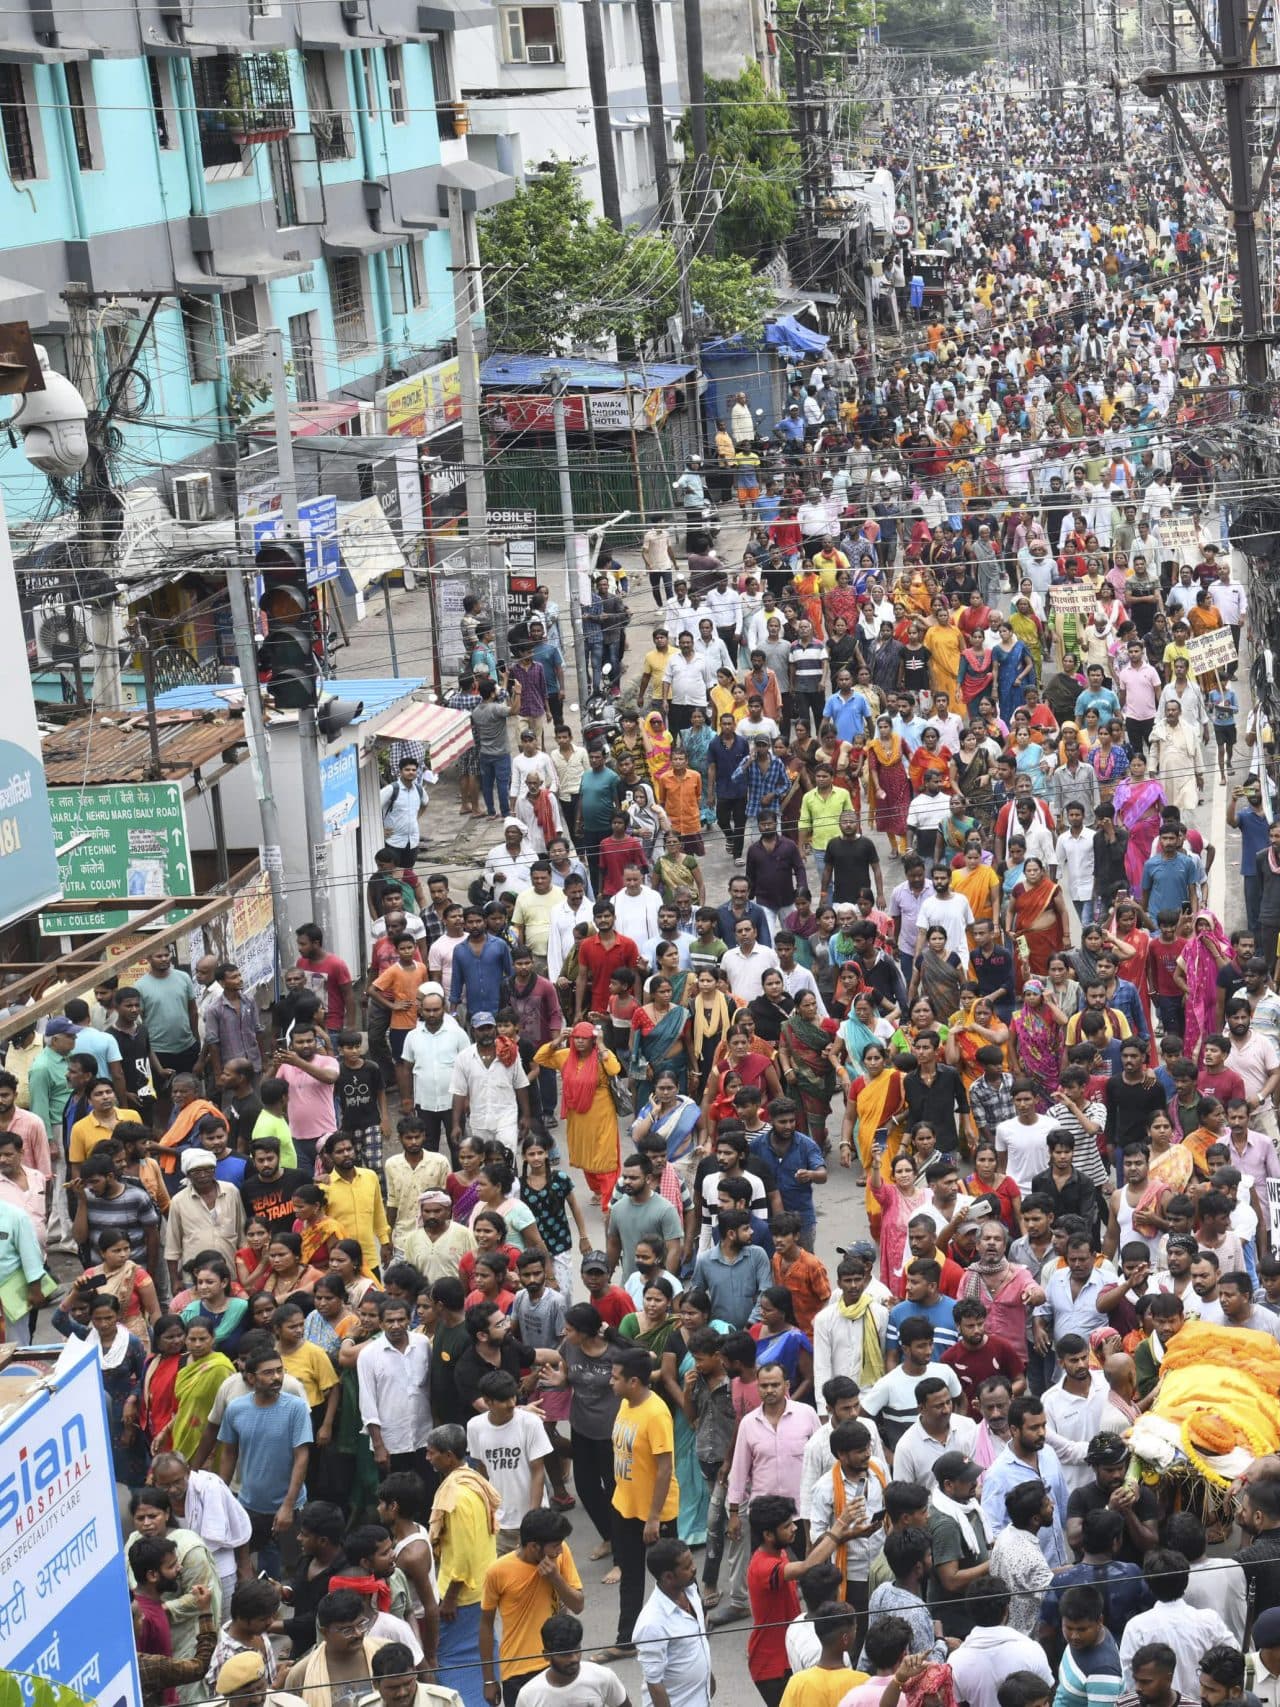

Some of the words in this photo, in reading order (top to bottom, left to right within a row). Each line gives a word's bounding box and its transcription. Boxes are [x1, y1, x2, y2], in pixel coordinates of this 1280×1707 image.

[594, 417, 622, 426] HOTEL
[86, 811, 110, 822] NEHRU
[111, 809, 132, 820] MARG
[90, 879, 121, 890] COLONY
[69, 914, 106, 926] COLLEGE
[485, 1447, 522, 1459] METRO
[15, 1453, 92, 1535] HOSPITAL
[13, 1507, 60, 1563] SPECIALITY
[53, 1489, 82, 1526] CARE
[36, 1516, 98, 1600] अस्पताल
